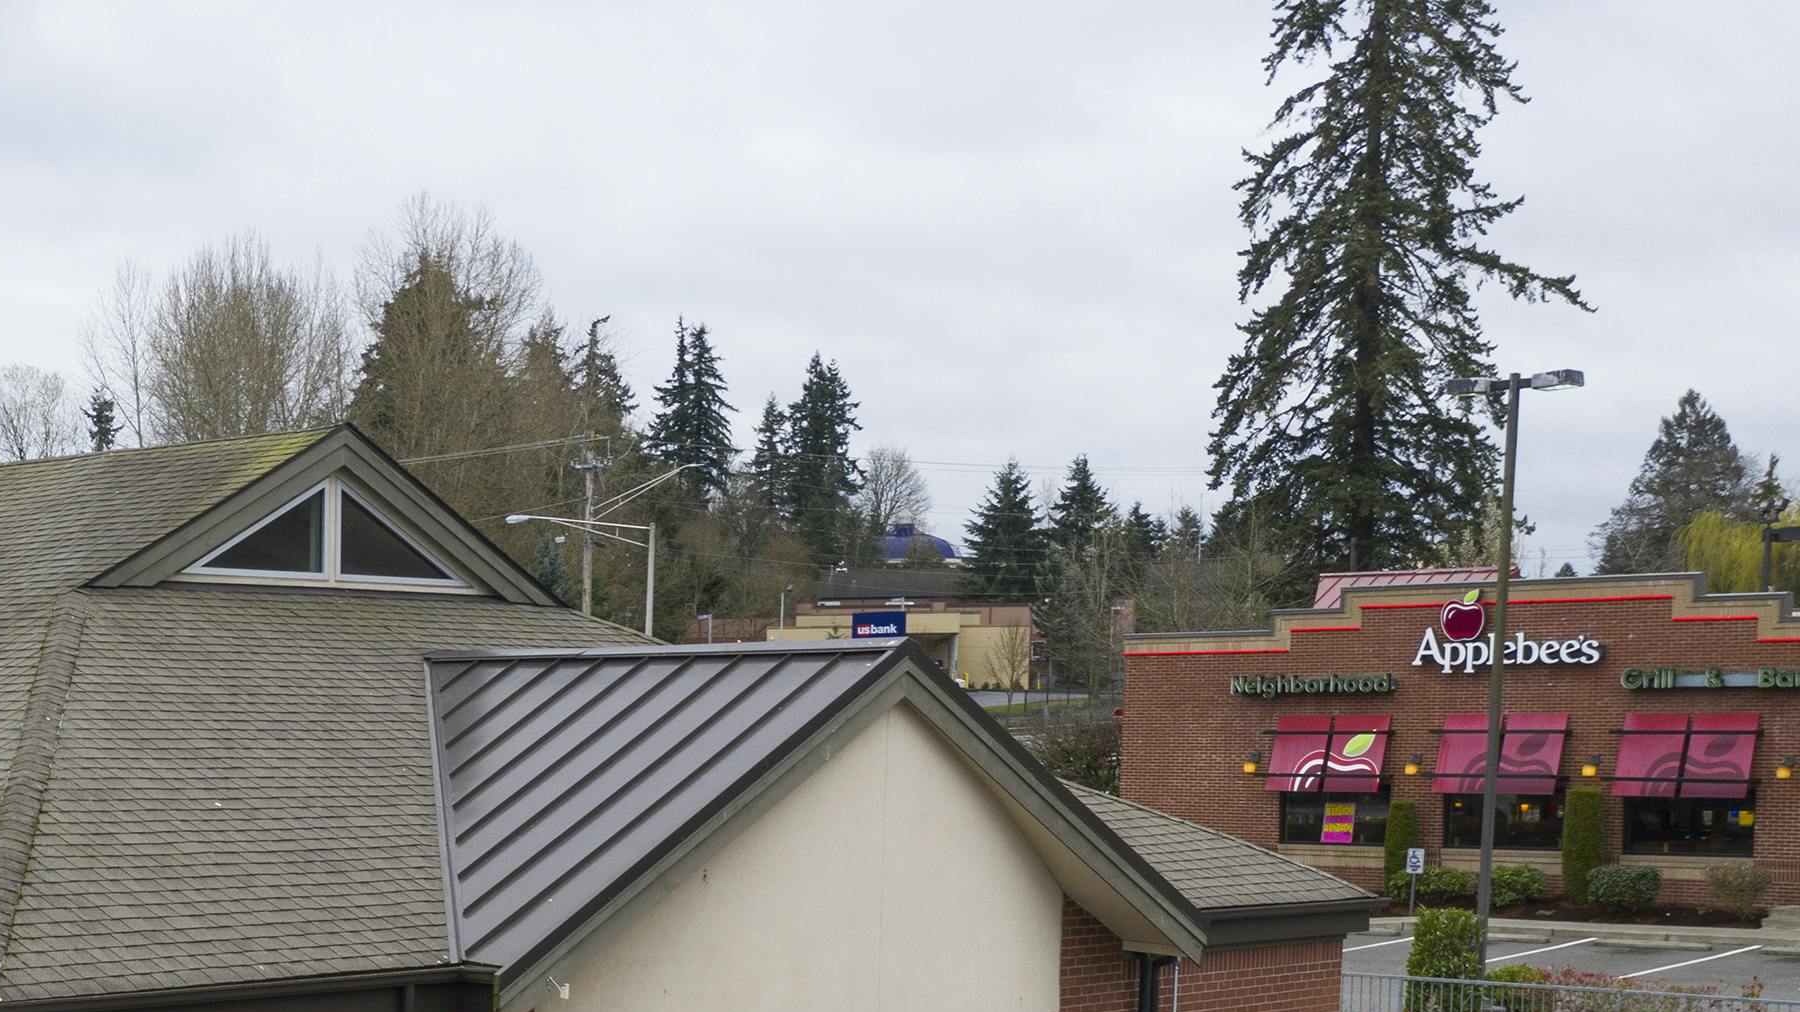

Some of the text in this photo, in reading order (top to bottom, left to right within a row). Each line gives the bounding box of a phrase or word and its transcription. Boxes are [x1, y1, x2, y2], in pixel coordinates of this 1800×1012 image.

[1411, 627, 1600, 673] Applebee's
[1230, 673, 1392, 699] Neighborhood
[1620, 667, 1676, 689] Grill
[1704, 665, 1725, 688] &
